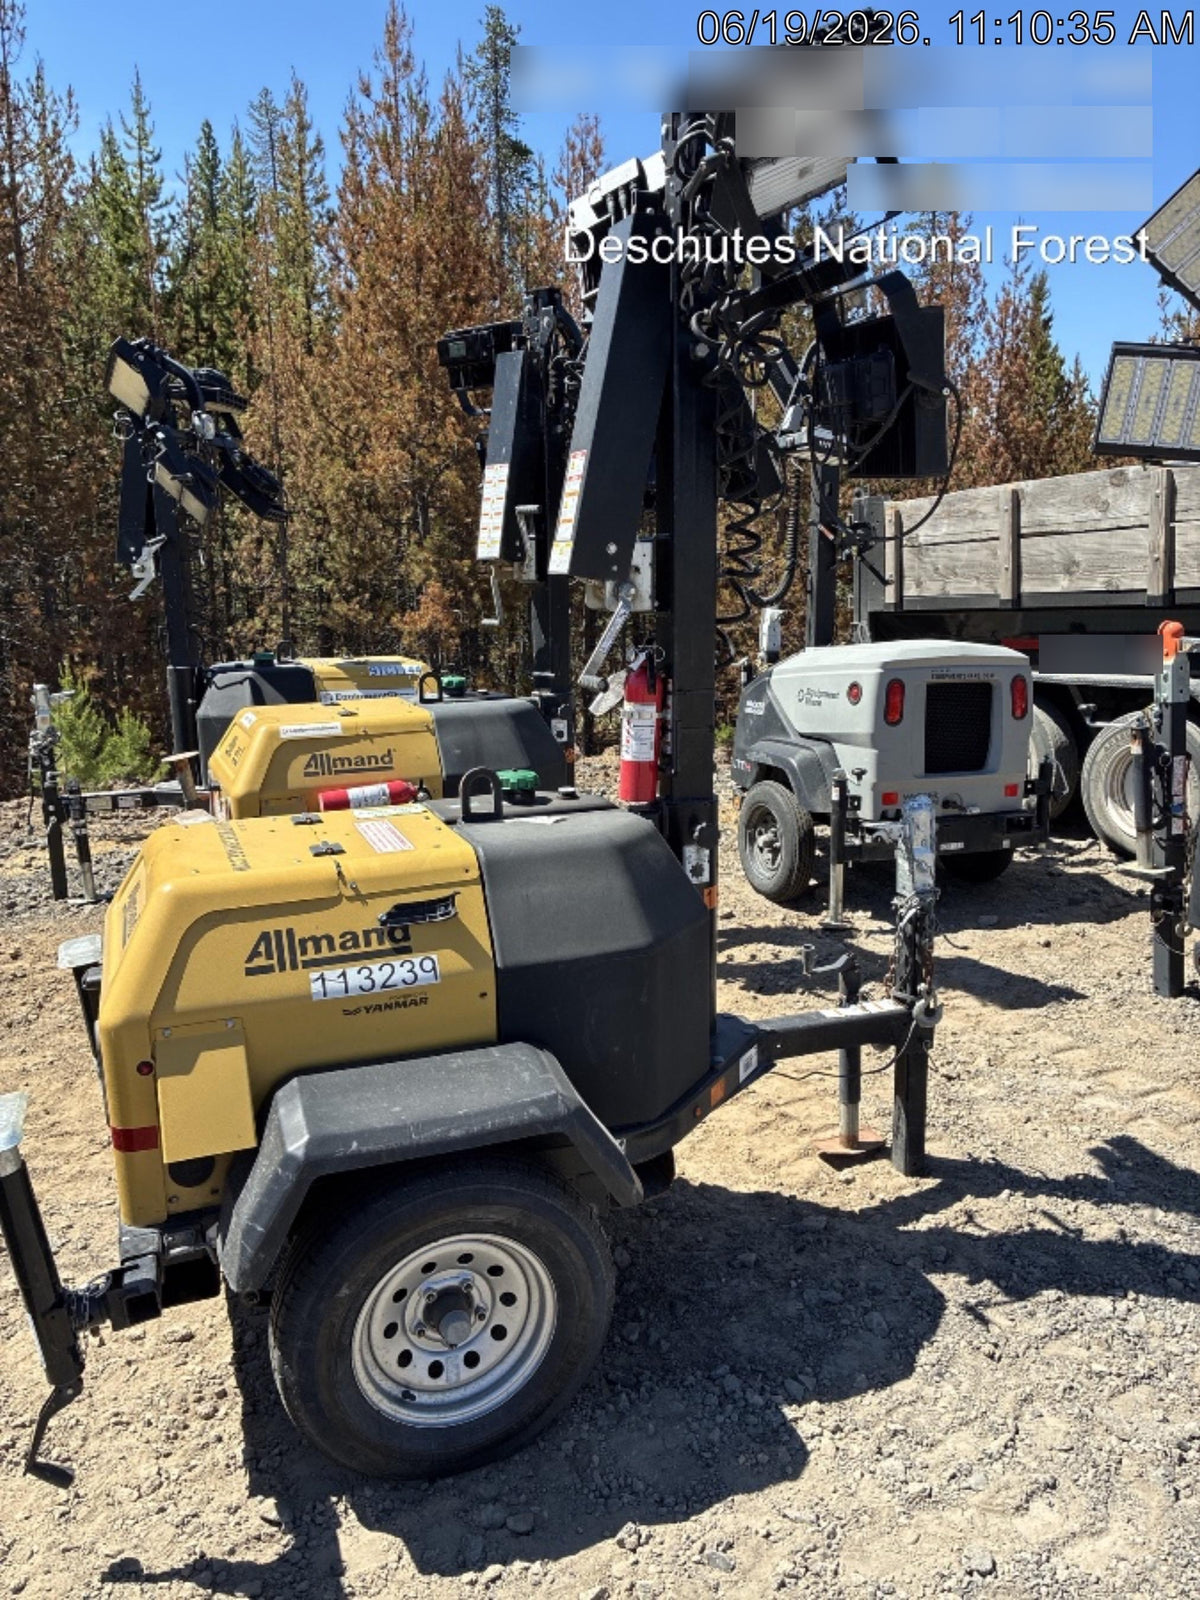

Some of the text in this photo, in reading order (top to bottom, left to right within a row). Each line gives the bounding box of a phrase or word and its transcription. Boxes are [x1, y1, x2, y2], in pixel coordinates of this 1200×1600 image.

[303, 748, 394, 776] Allmand
[244, 924, 413, 974] Allmand
[312, 956, 439, 998] 113239
[362, 996, 430, 1014] YANMAR
